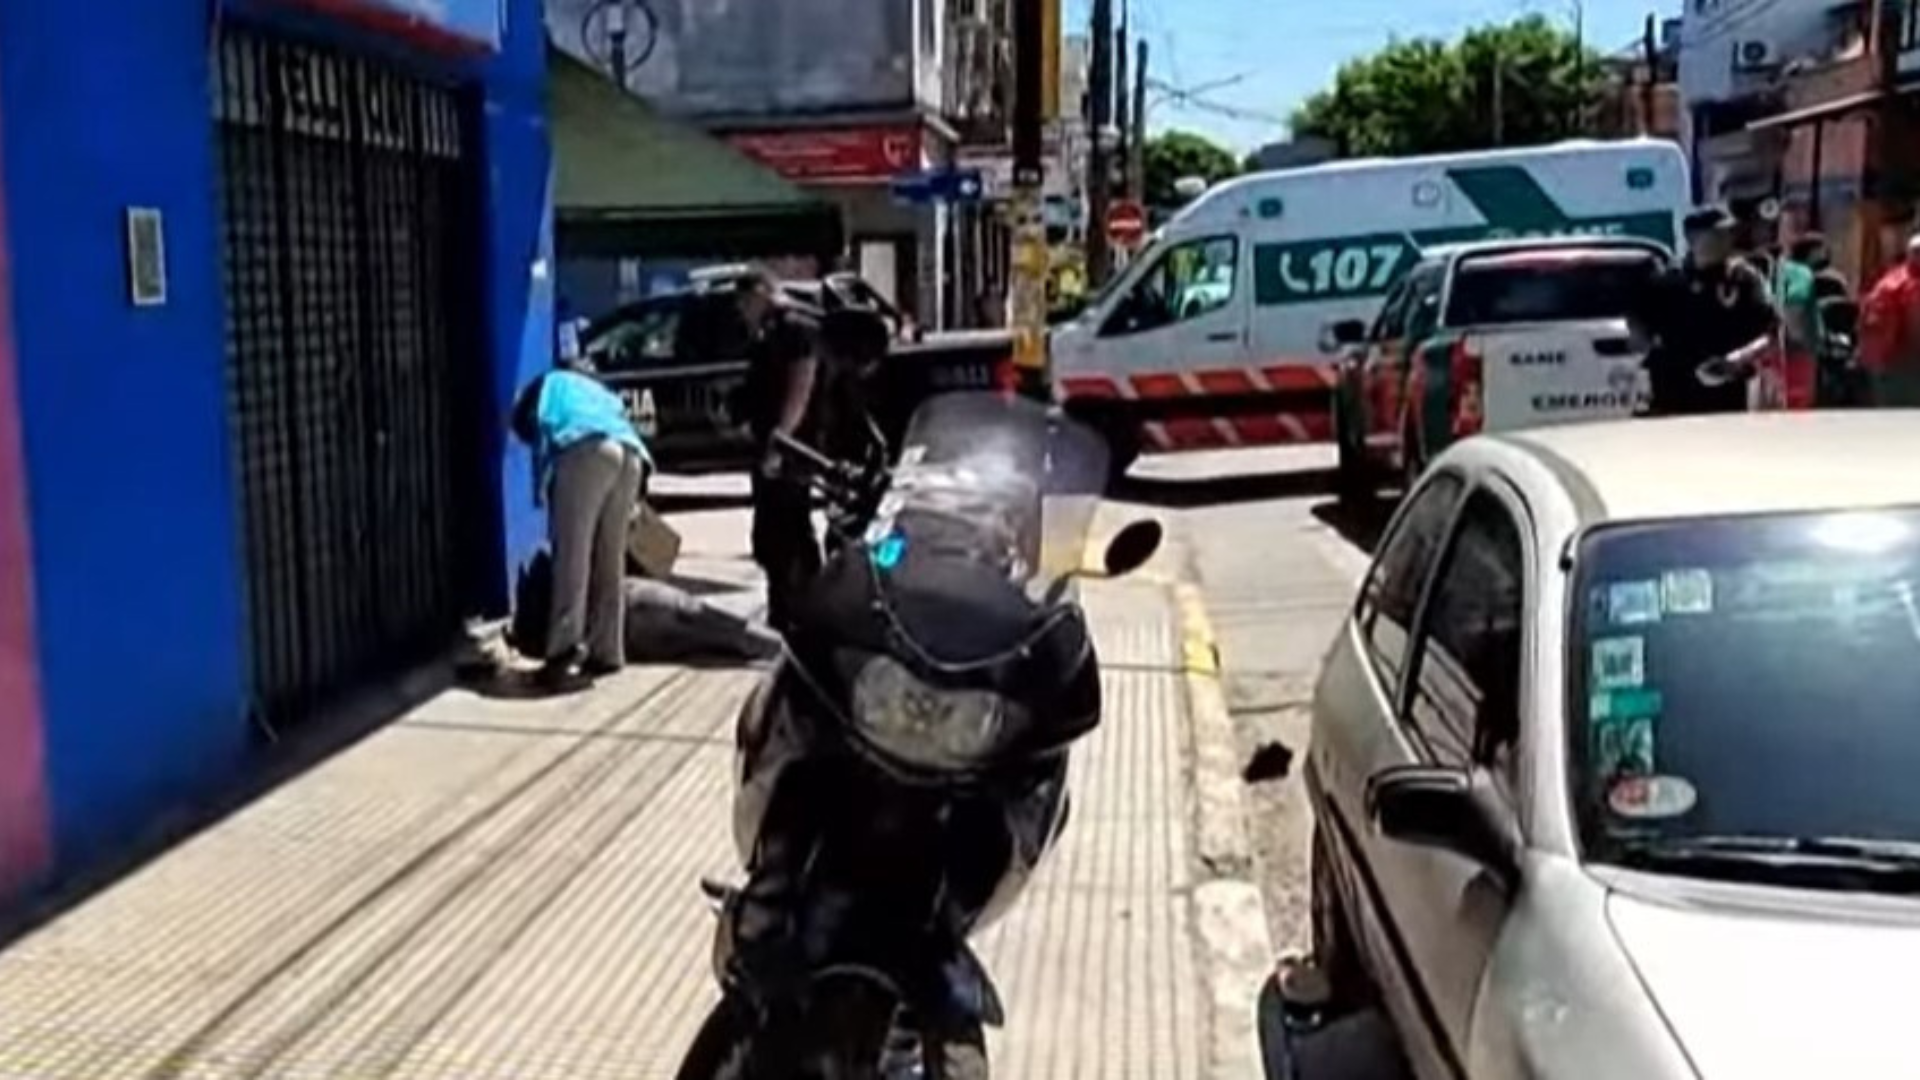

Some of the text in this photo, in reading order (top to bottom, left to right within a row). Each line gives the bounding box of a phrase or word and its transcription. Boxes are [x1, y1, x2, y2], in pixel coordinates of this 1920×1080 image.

[1309, 243, 1403, 293] 107
[1509, 351, 1567, 365] SAME
[620, 388, 656, 417] CIA
[1531, 391, 1653, 411] EMERGEN
